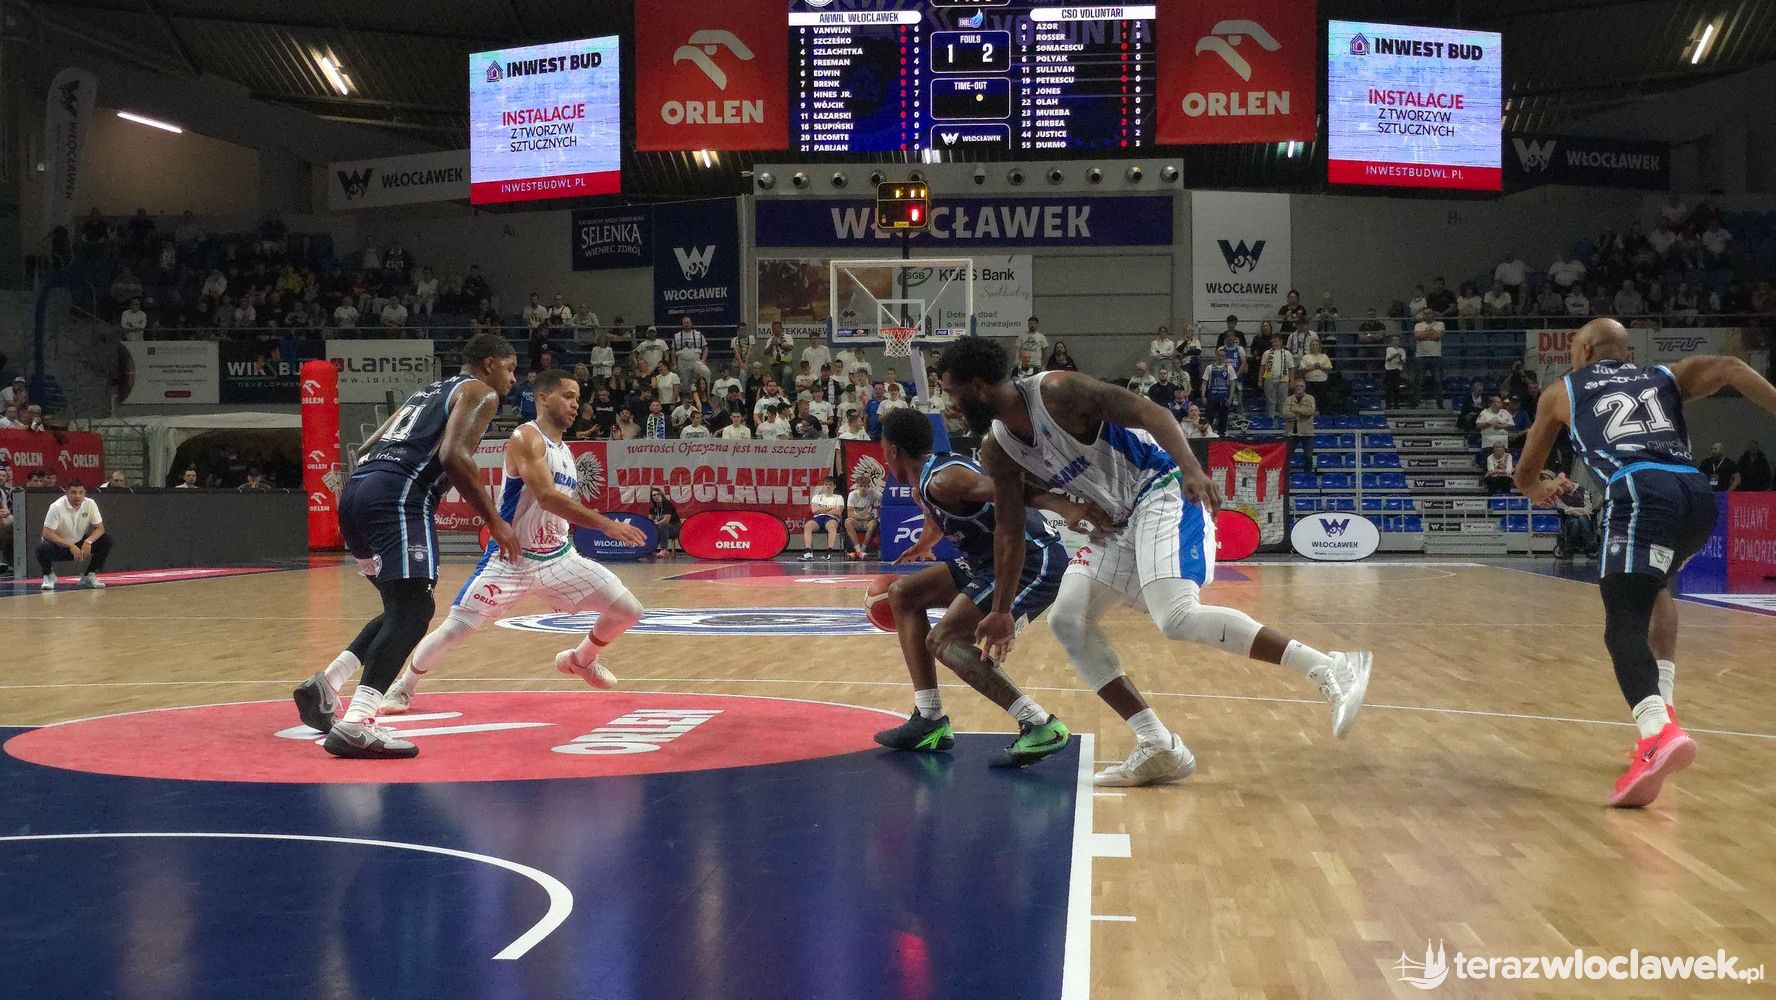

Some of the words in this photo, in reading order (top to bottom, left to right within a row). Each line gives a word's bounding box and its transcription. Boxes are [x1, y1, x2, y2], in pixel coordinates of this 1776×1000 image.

[819, 13, 846, 23] ANWIL
[1062, 9, 1078, 18] CSO
[1080, 8, 1124, 18] VOLUNTARI
[960, 35, 981, 44] FOULS
[814, 48, 864, 56] SZLACHETKA
[948, 44, 954, 63] 1
[982, 44, 993, 63] 2
[1036, 44, 1084, 52] SOMACESCU
[1374, 38, 1442, 59] INWEST
[1448, 43, 1483, 61] BUD
[506, 55, 566, 78] INWEST
[570, 52, 602, 73] BUD
[1036, 54, 1068, 62] POLYAK
[1036, 66, 1074, 74] SULLIVAN
[954, 82, 988, 90] TIME-OUT
[814, 100, 844, 108] WÓJCIK
[1181, 90, 1290, 117] ORLEN
[1368, 88, 1464, 110] INSTALACJE
[502, 103, 585, 126] INSTALACJE
[661, 100, 764, 124] ORLEN
[1036, 108, 1070, 116] MUKEBA
[1378, 108, 1386, 119] Z
[1388, 108, 1452, 123] TWORZYW
[511, 128, 517, 139] Z
[518, 123, 574, 138] TWORZYW
[1036, 120, 1066, 128] GIRBEA
[1378, 122, 1455, 137] SZTUCZNYCH
[510, 136, 577, 152] SZTUCZNYCH
[1566, 150, 1660, 171] WŁOCŁAWEK
[382, 166, 463, 188] WŁOCŁAWEK
[1366, 166, 1464, 180] INWESTBUDWL.PL
[831, 205, 1092, 240] WCŁAWEK
[581, 224, 642, 250] SELENKA
[982, 269, 1015, 281] Bank
[664, 286, 728, 302] WŁOCŁAWEK
[1206, 282, 1278, 294] WŁOCŁAWEK
[1593, 386, 1675, 444] 21
[627, 443, 675, 454] wartości
[679, 442, 728, 455] Ojczyzna
[731, 443, 750, 454] jest
[772, 443, 816, 456] szczycie
[14, 452, 43, 466] ORLEN
[73, 454, 99, 468] ORLEN
[715, 541, 750, 549] ORLEN
[550, 709, 726, 755] ORLEN
